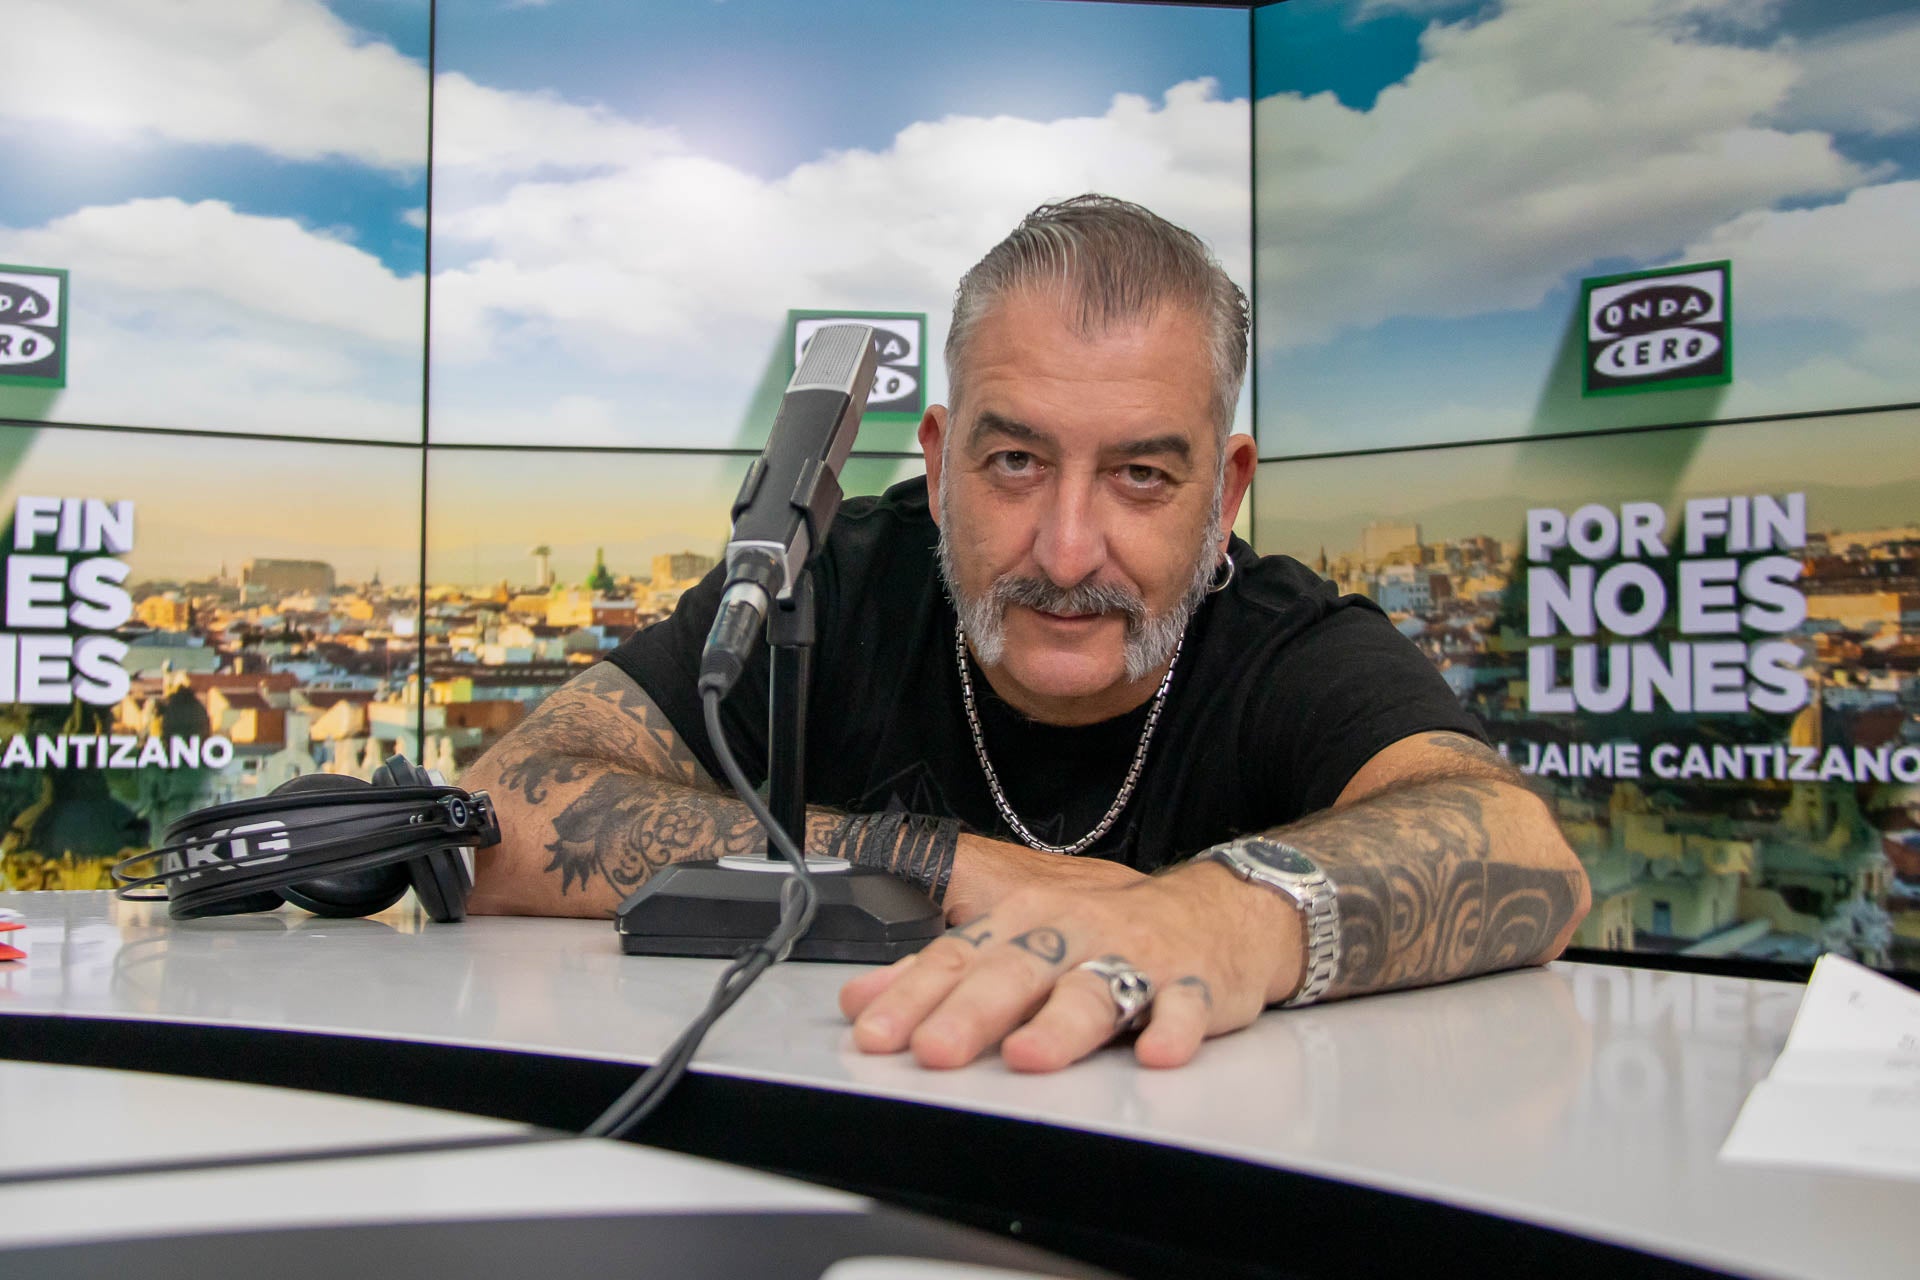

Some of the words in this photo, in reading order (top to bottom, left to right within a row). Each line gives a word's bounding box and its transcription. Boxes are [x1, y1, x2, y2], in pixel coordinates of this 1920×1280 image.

[1605, 295, 1703, 327] ONDA
[1611, 337, 1702, 368] CERO
[14, 496, 134, 553] FIN
[1526, 504, 1668, 562] POR
[1685, 493, 1806, 554] FIN
[5, 555, 133, 631] ES
[1527, 562, 1667, 638] NO
[1679, 555, 1806, 634] ES
[1527, 640, 1809, 714] LUNES
[0, 733, 234, 769] ANTIZANO
[1520, 742, 1641, 778] JAIME
[1650, 743, 1920, 783] CANTIZANO
[164, 820, 291, 885] AKG
